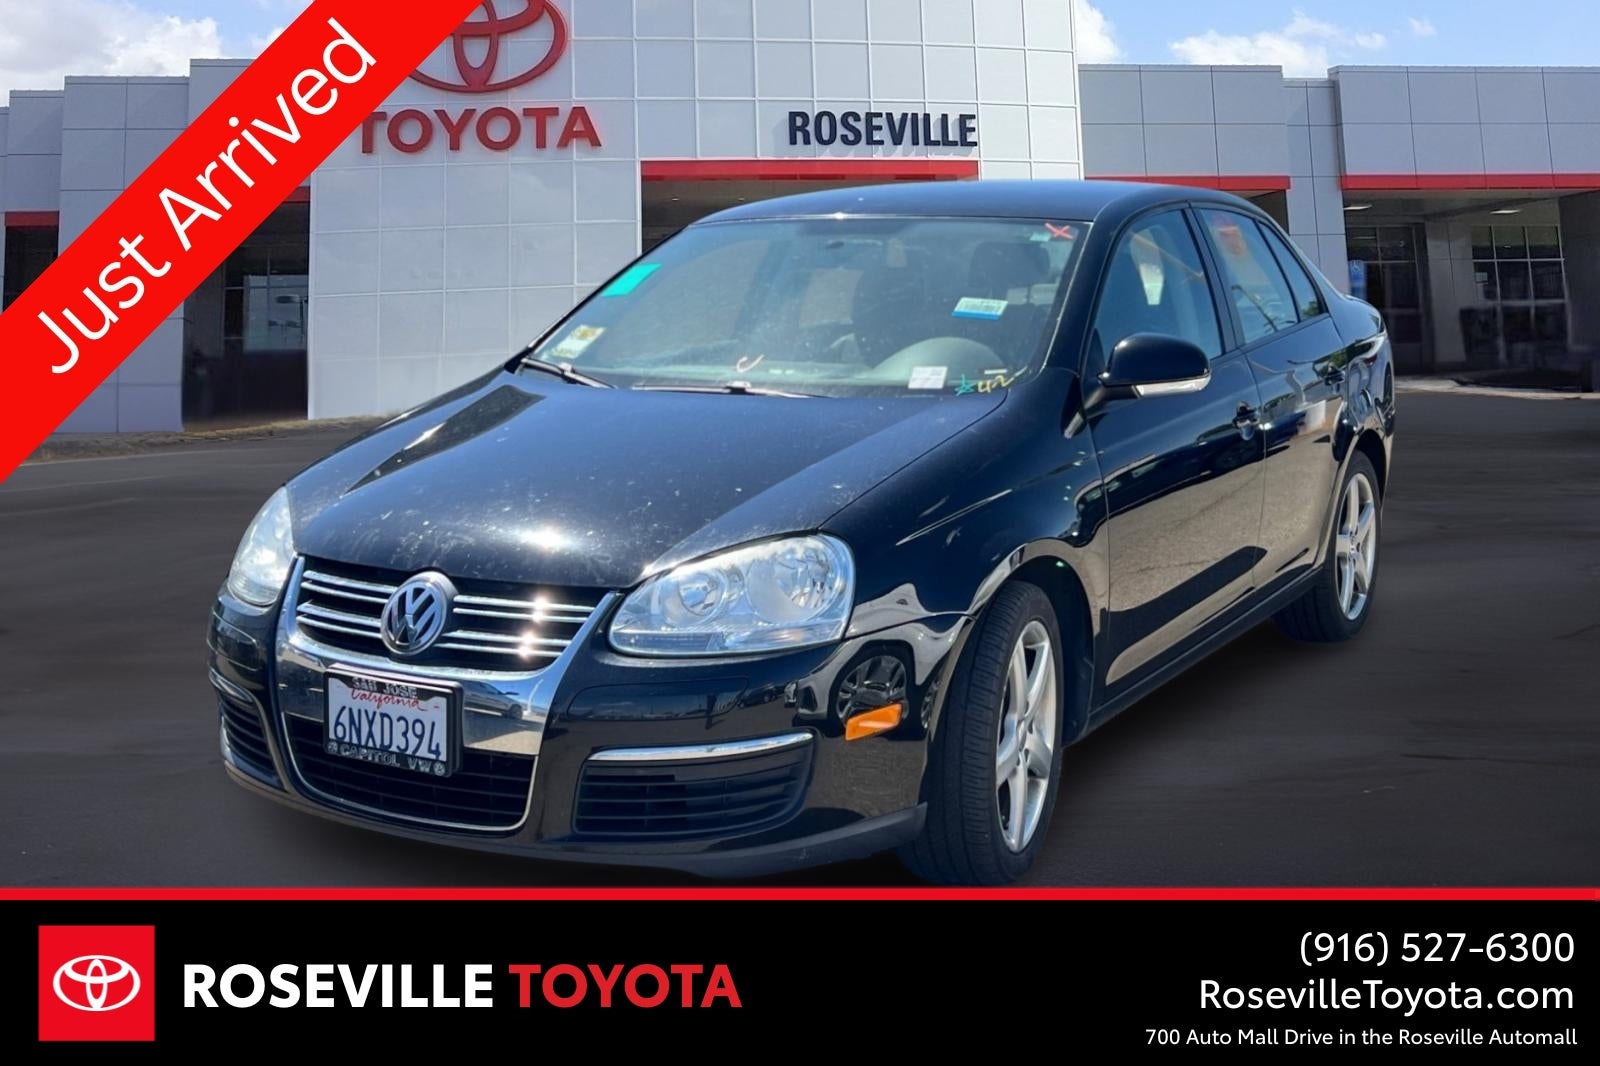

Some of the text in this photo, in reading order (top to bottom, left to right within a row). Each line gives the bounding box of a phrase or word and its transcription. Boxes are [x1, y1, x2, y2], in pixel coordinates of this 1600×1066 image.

[361, 106, 602, 154] TOYOTA
[788, 110, 978, 147] ROSEVILLE
[384, 684, 417, 698] JOSE
[333, 705, 442, 761] 6NXD394
[340, 743, 432, 772] CAPITOL VW
